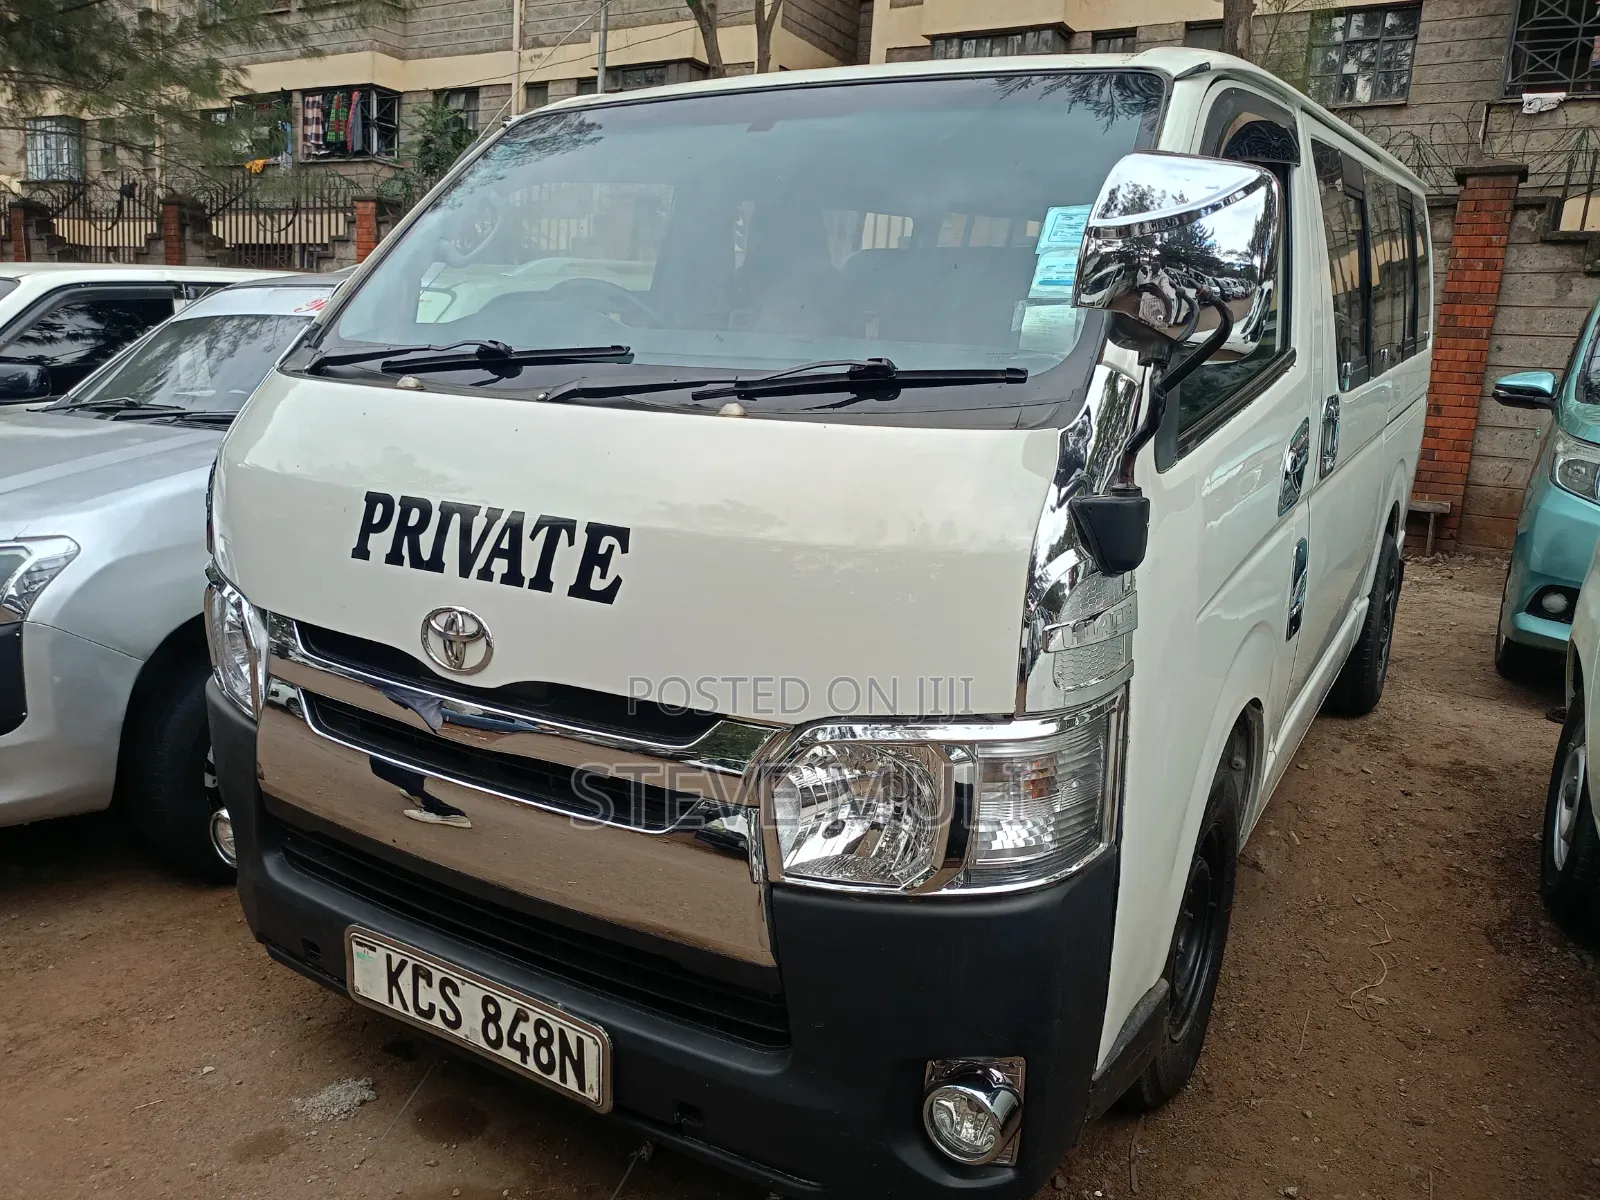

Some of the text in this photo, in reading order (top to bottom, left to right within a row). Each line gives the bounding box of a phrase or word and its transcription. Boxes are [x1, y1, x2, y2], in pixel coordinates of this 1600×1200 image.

[351, 491, 630, 605] PRIVATE
[386, 952, 462, 1030] KCS
[481, 994, 586, 1094] 848N
